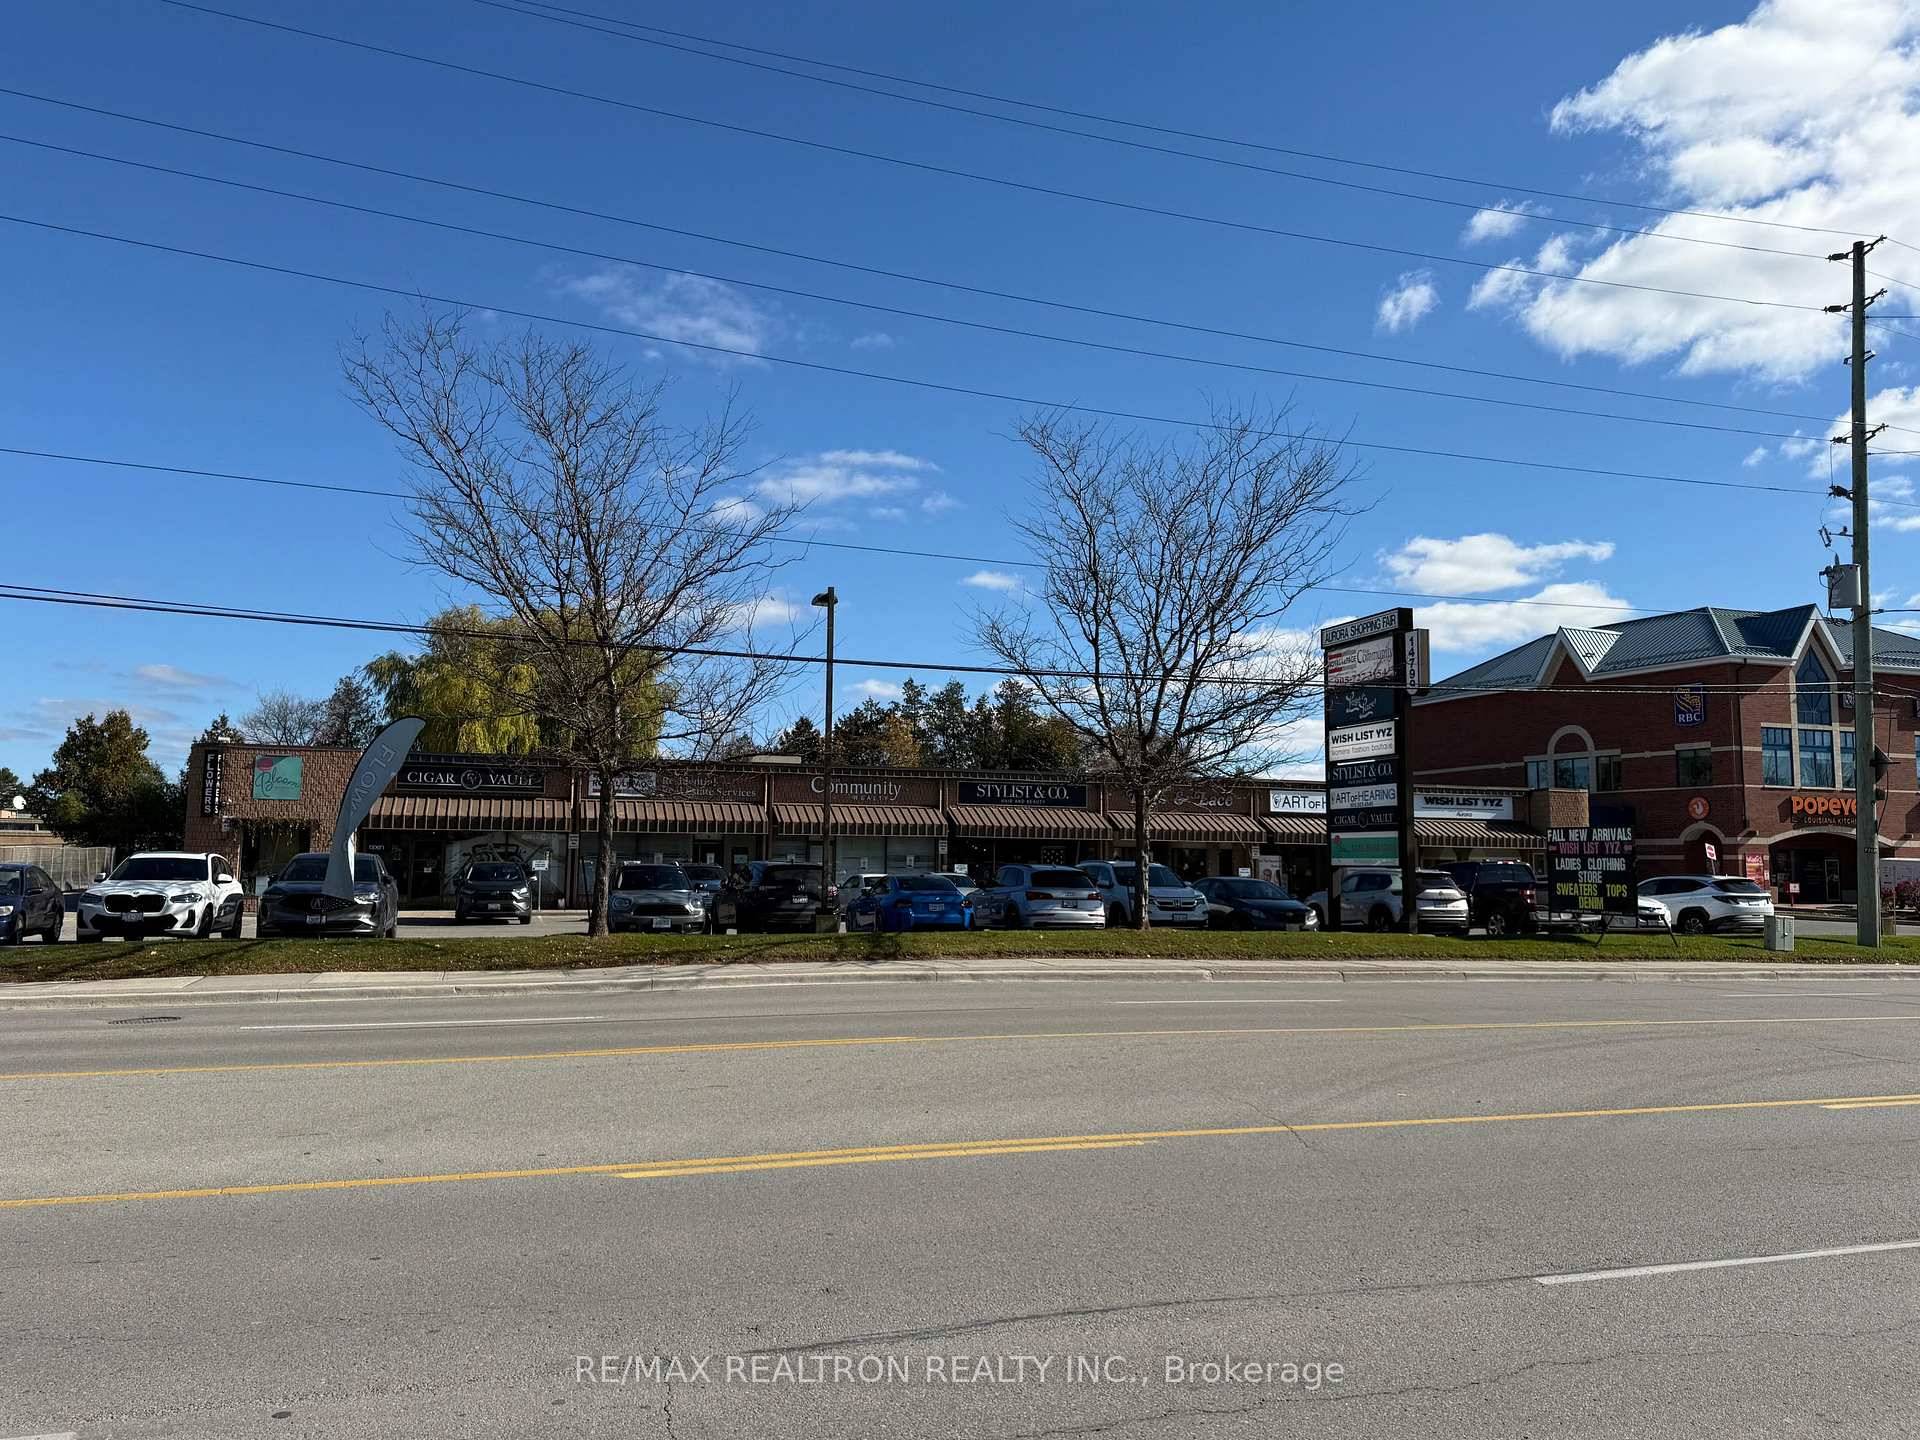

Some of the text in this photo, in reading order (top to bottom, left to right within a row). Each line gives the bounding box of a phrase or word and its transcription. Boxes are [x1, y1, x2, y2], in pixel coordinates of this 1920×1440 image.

[1325, 614, 1396, 642] AURORA SHOPPING FAIR
[1678, 712, 1701, 723] RBC
[1331, 727, 1393, 744] WISH LIST YYZ
[407, 771, 456, 784] CIGAR
[489, 773, 534, 786] VAULT
[1333, 765, 1367, 781] STYLIST
[1368, 763, 1376, 777] &
[204, 753, 215, 814] FLOWERS
[976, 783, 1070, 800] STYLIST & CO.
[1335, 791, 1351, 804] ART
[1358, 787, 1396, 802] HEARING
[1282, 796, 1308, 809] ART
[1424, 796, 1503, 807] WISH LIST YYZ
[1334, 813, 1393, 825] CIGAR VAULT
[1803, 816, 1857, 825] LOUISIANA KITCH
[1547, 827, 1632, 842] FALL NEW ARRIVALS
[1559, 842, 1621, 855] WISH LIST YYZ
[1555, 857, 1626, 871] LADIES CLOTHING
[1578, 871, 1603, 884] STORE
[1556, 882, 1628, 897] SWEATERS TOPS
[1578, 896, 1604, 910] DENIM
